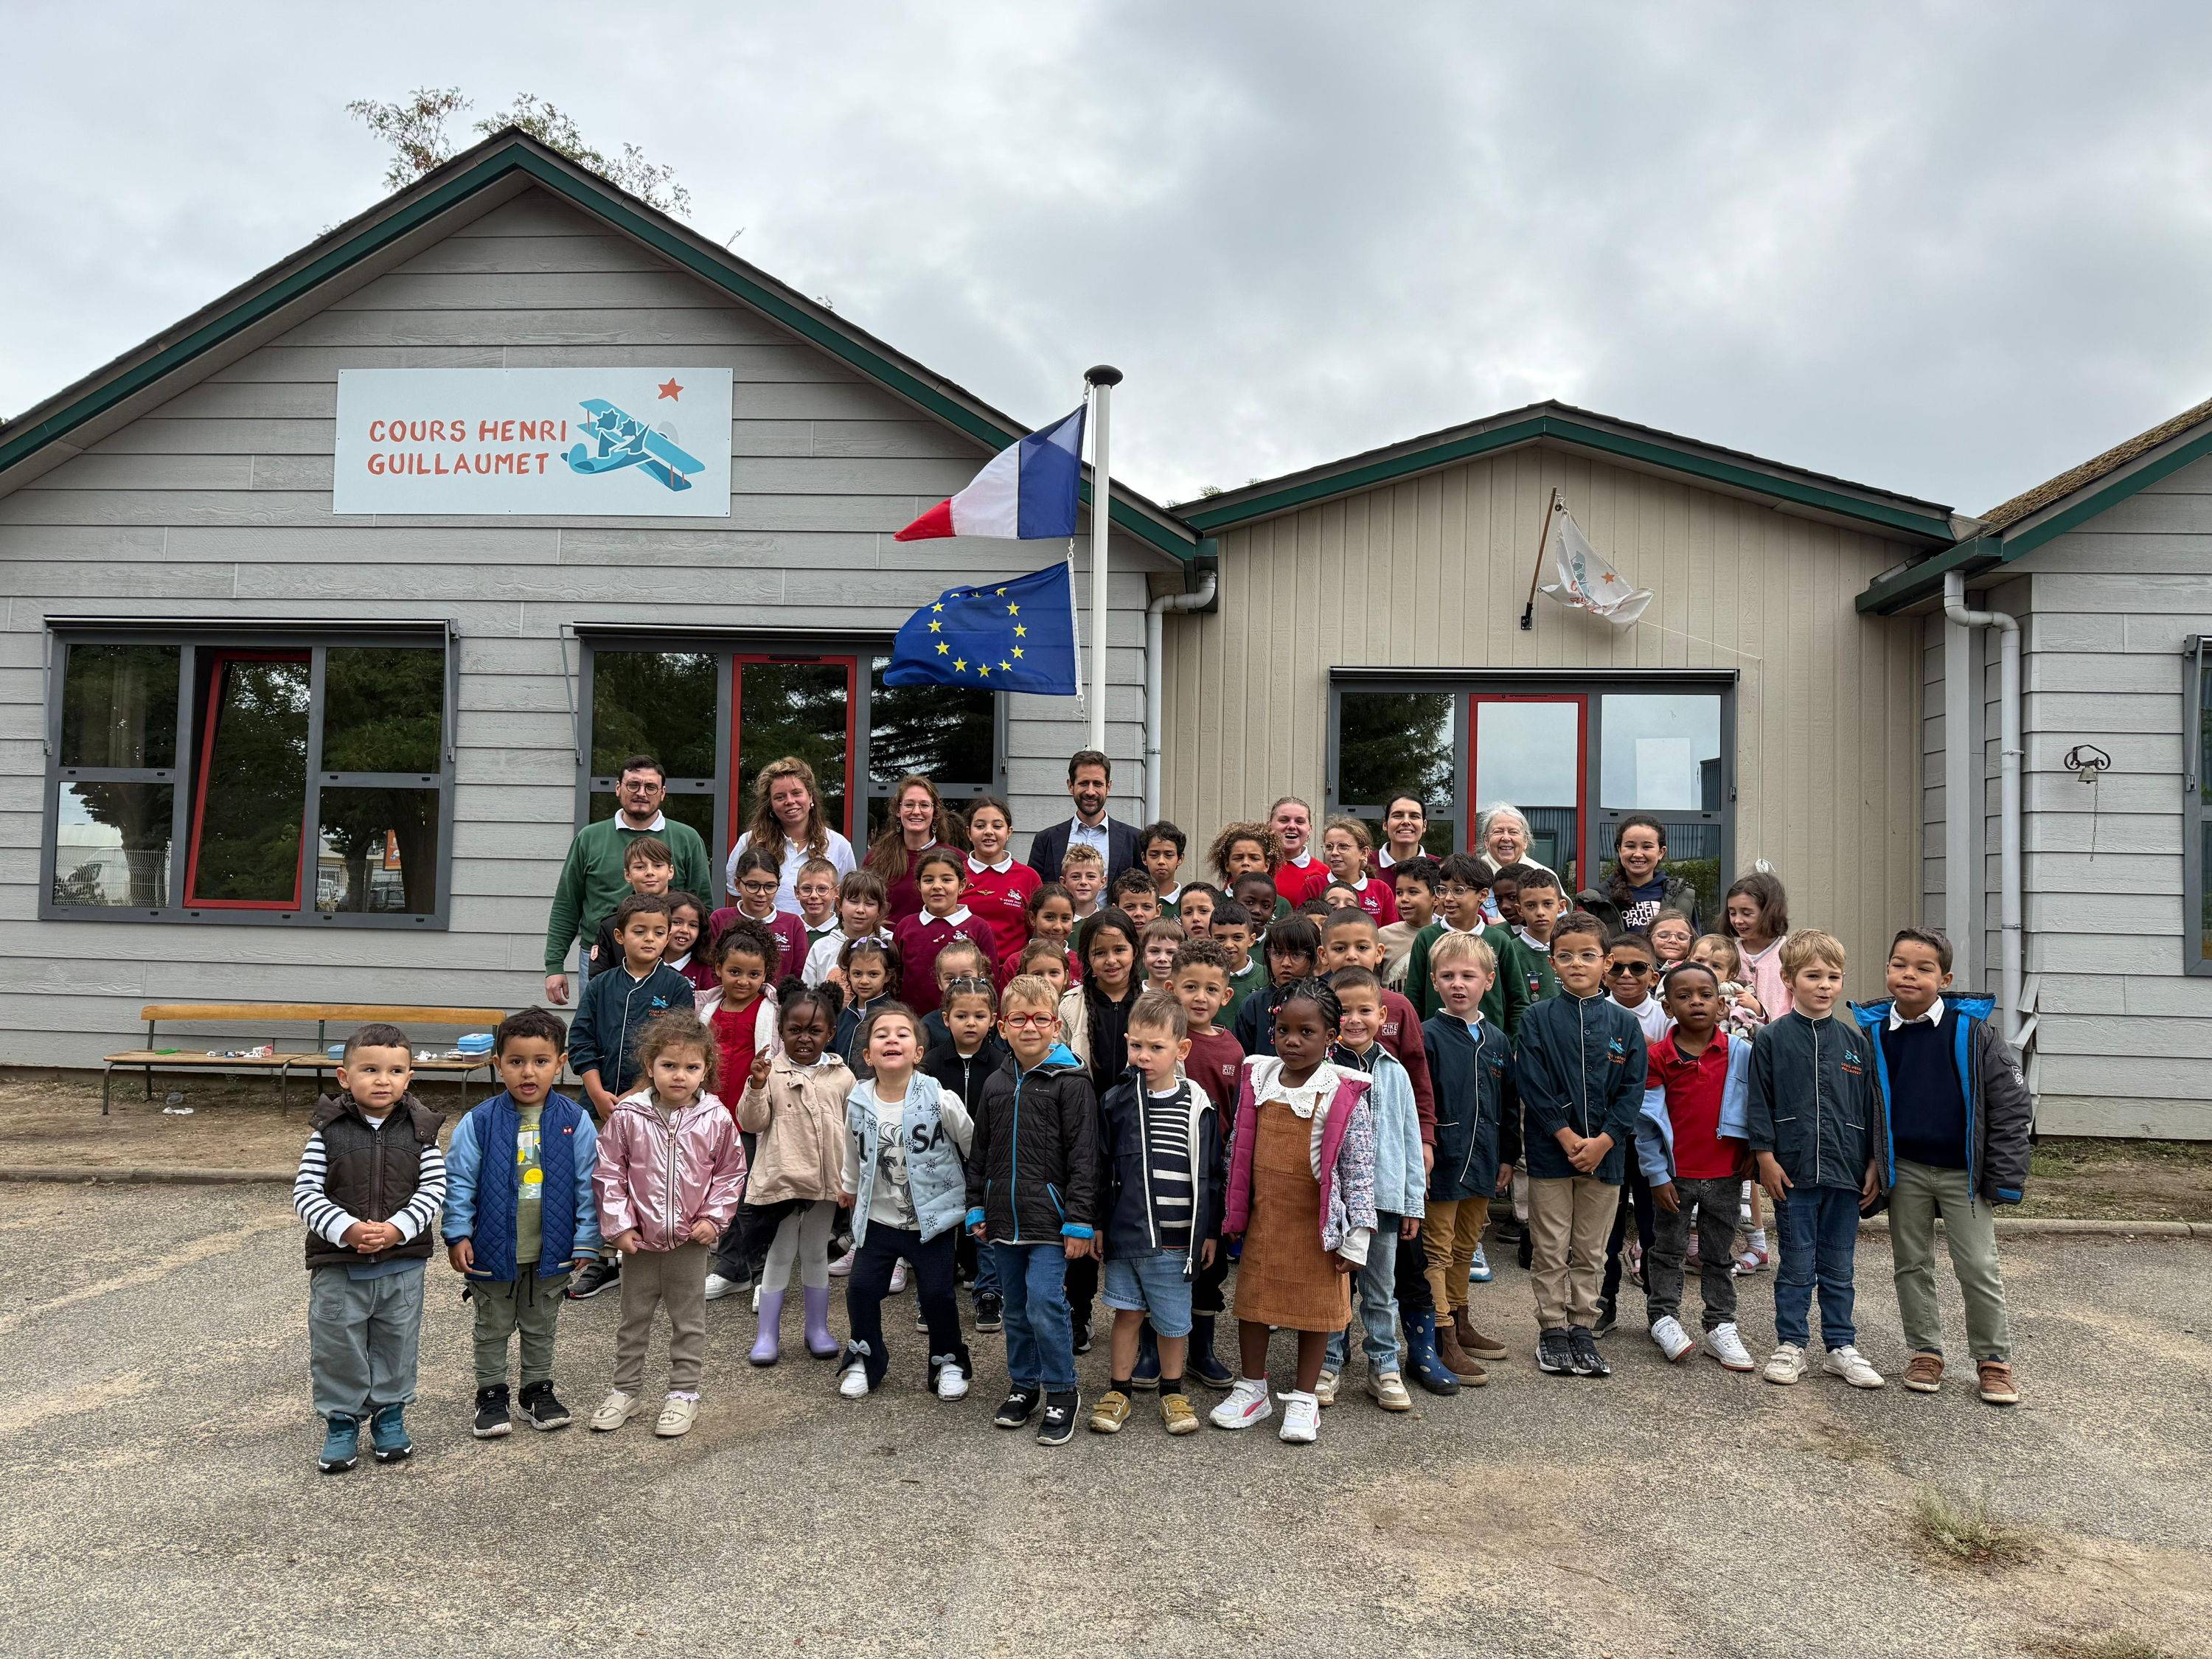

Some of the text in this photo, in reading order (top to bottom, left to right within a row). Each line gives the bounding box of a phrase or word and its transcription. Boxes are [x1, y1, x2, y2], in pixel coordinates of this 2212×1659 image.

[370, 420, 566, 442] COURS HENRI
[368, 453, 548, 475] GUILLAUMET
[1631, 900, 1651, 910] HE
[1621, 908, 1653, 919] ORTH
